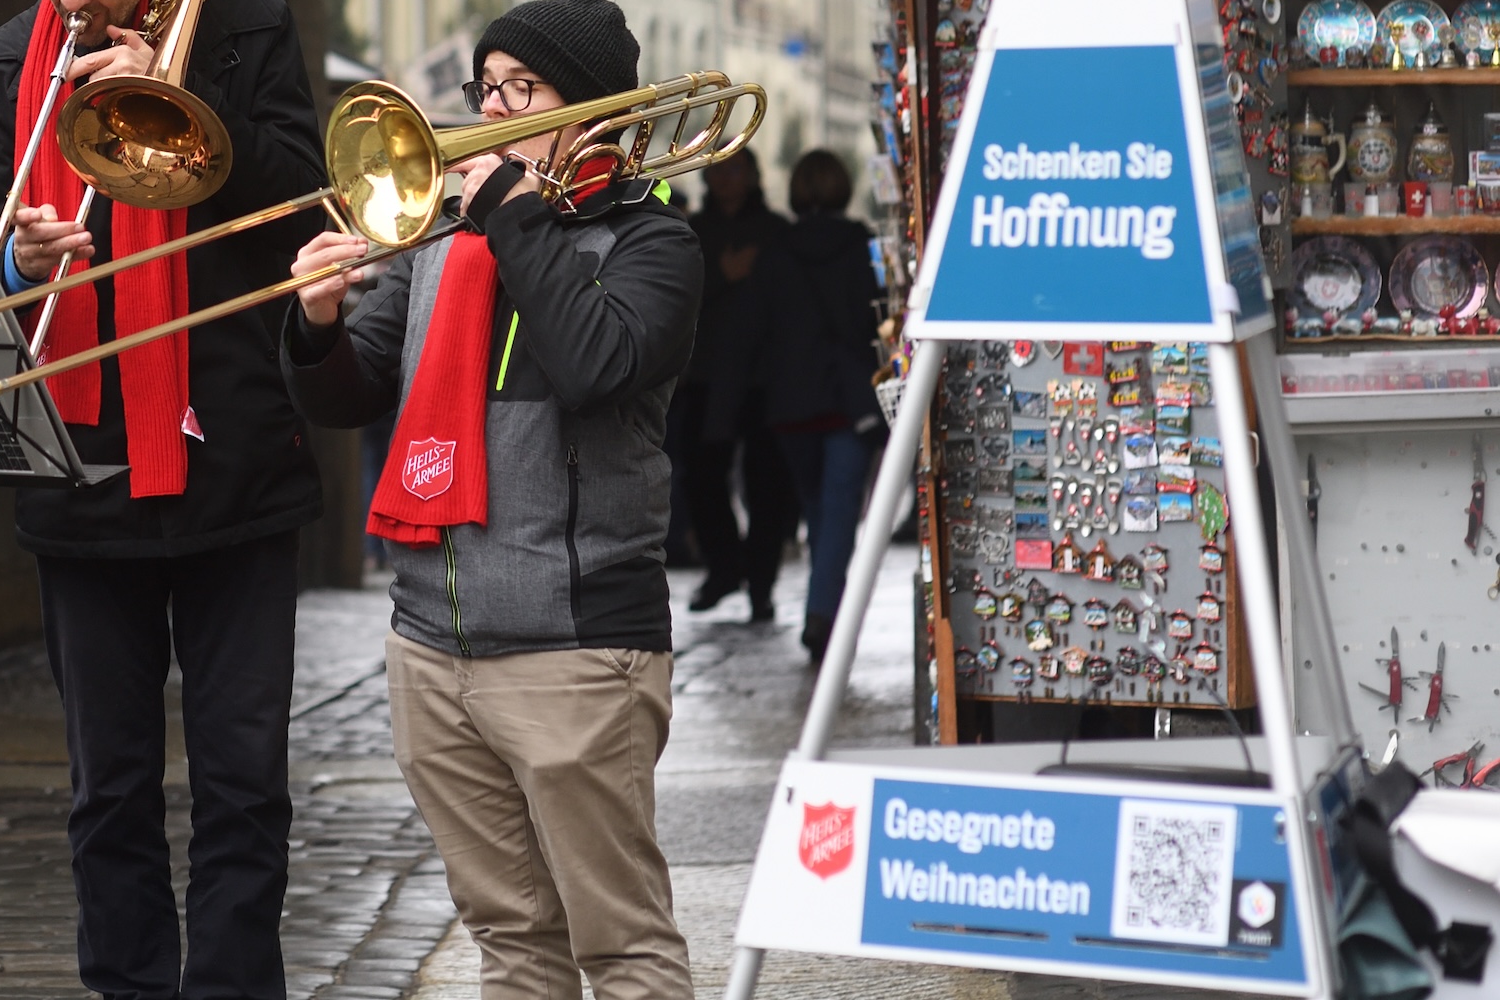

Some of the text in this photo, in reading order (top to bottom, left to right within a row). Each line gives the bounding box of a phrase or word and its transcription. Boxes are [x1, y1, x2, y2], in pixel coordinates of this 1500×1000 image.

[983, 142, 1173, 180] Schenken Sie
[971, 192, 1177, 259] Hoffnung
[406, 445, 446, 476] HEILS-
[411, 456, 451, 490] ARMEE
[884, 798, 1055, 854] Gesegnete
[808, 829, 853, 870] ARMEE
[879, 857, 1091, 916] Weihnachten
